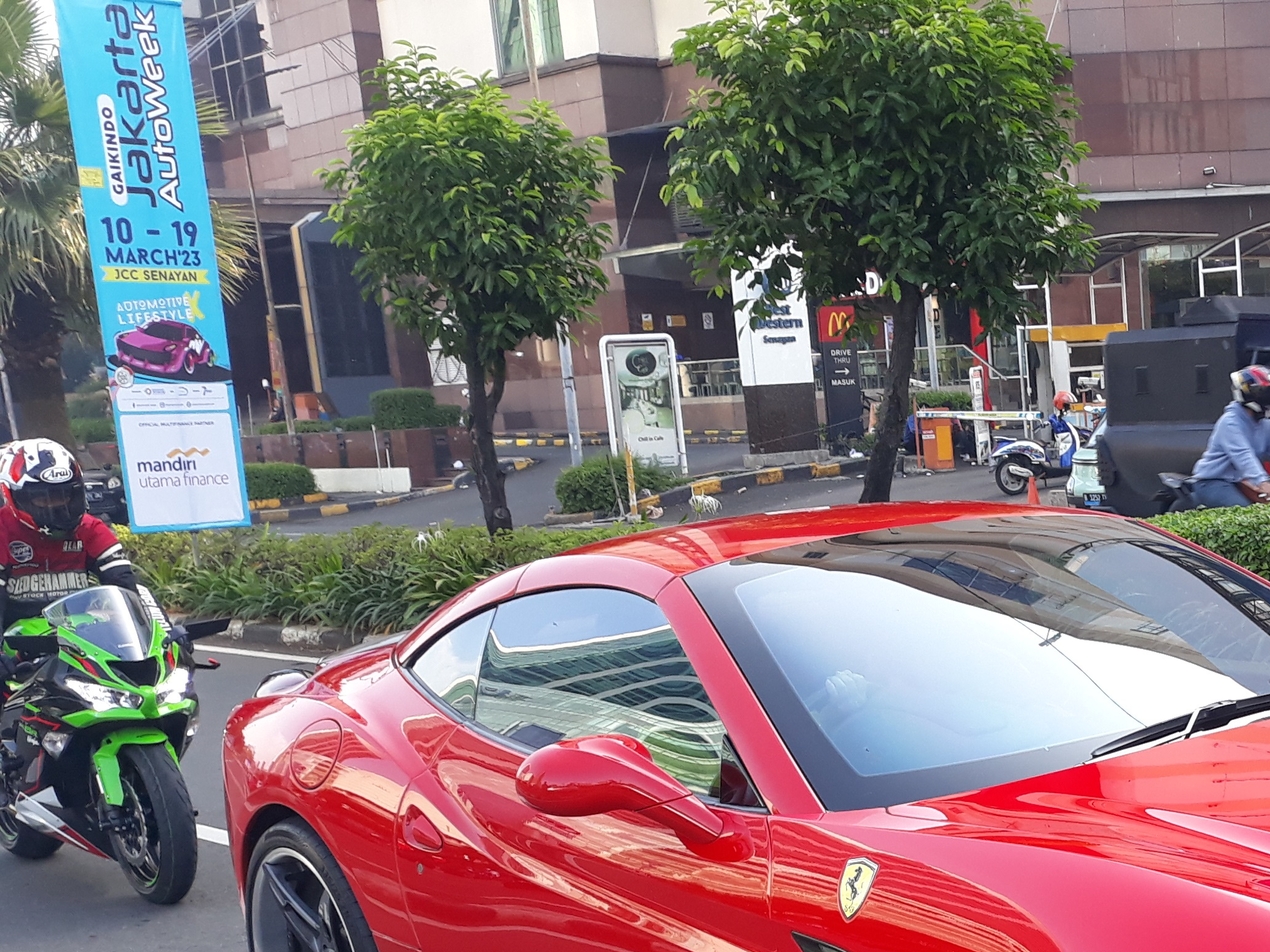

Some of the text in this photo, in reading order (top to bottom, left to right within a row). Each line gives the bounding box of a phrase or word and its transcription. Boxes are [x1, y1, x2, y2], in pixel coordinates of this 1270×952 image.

[104, 4, 157, 208] Jakarta
[132, 2, 184, 212] AutoWeek
[102, 107, 124, 195] GAIKINDO
[100, 217, 133, 244] 10
[171, 221, 198, 247] 19
[105, 246, 202, 267] MARCH'23
[115, 269, 198, 282] JCC SENAYAN
[118, 308, 194, 324] LIFESTYLE
[45, 468, 70, 481] Arai
[137, 457, 197, 473] mandiri
[139, 472, 229, 488] utama finance
[6, 571, 89, 595] SLEDGEHAMMER
